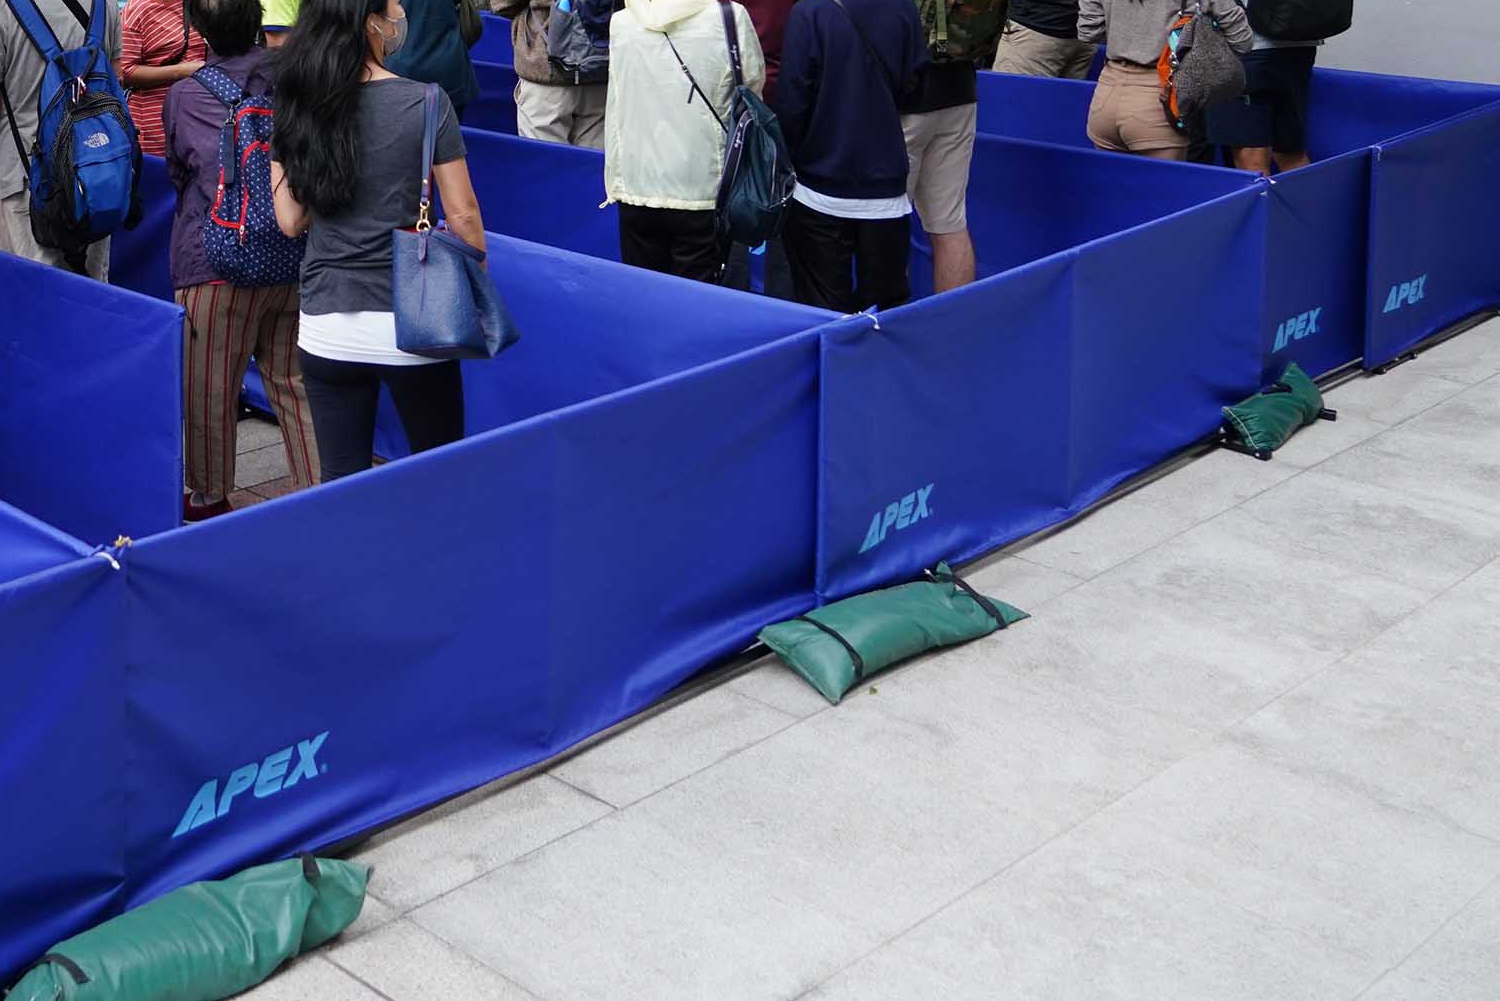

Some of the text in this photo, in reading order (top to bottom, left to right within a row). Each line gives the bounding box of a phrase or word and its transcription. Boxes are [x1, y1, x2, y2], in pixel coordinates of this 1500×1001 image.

[1381, 273, 1428, 314] APEX
[1271, 306, 1323, 354] APEX
[858, 482, 935, 555] APEX
[171, 730, 330, 839] APEX
